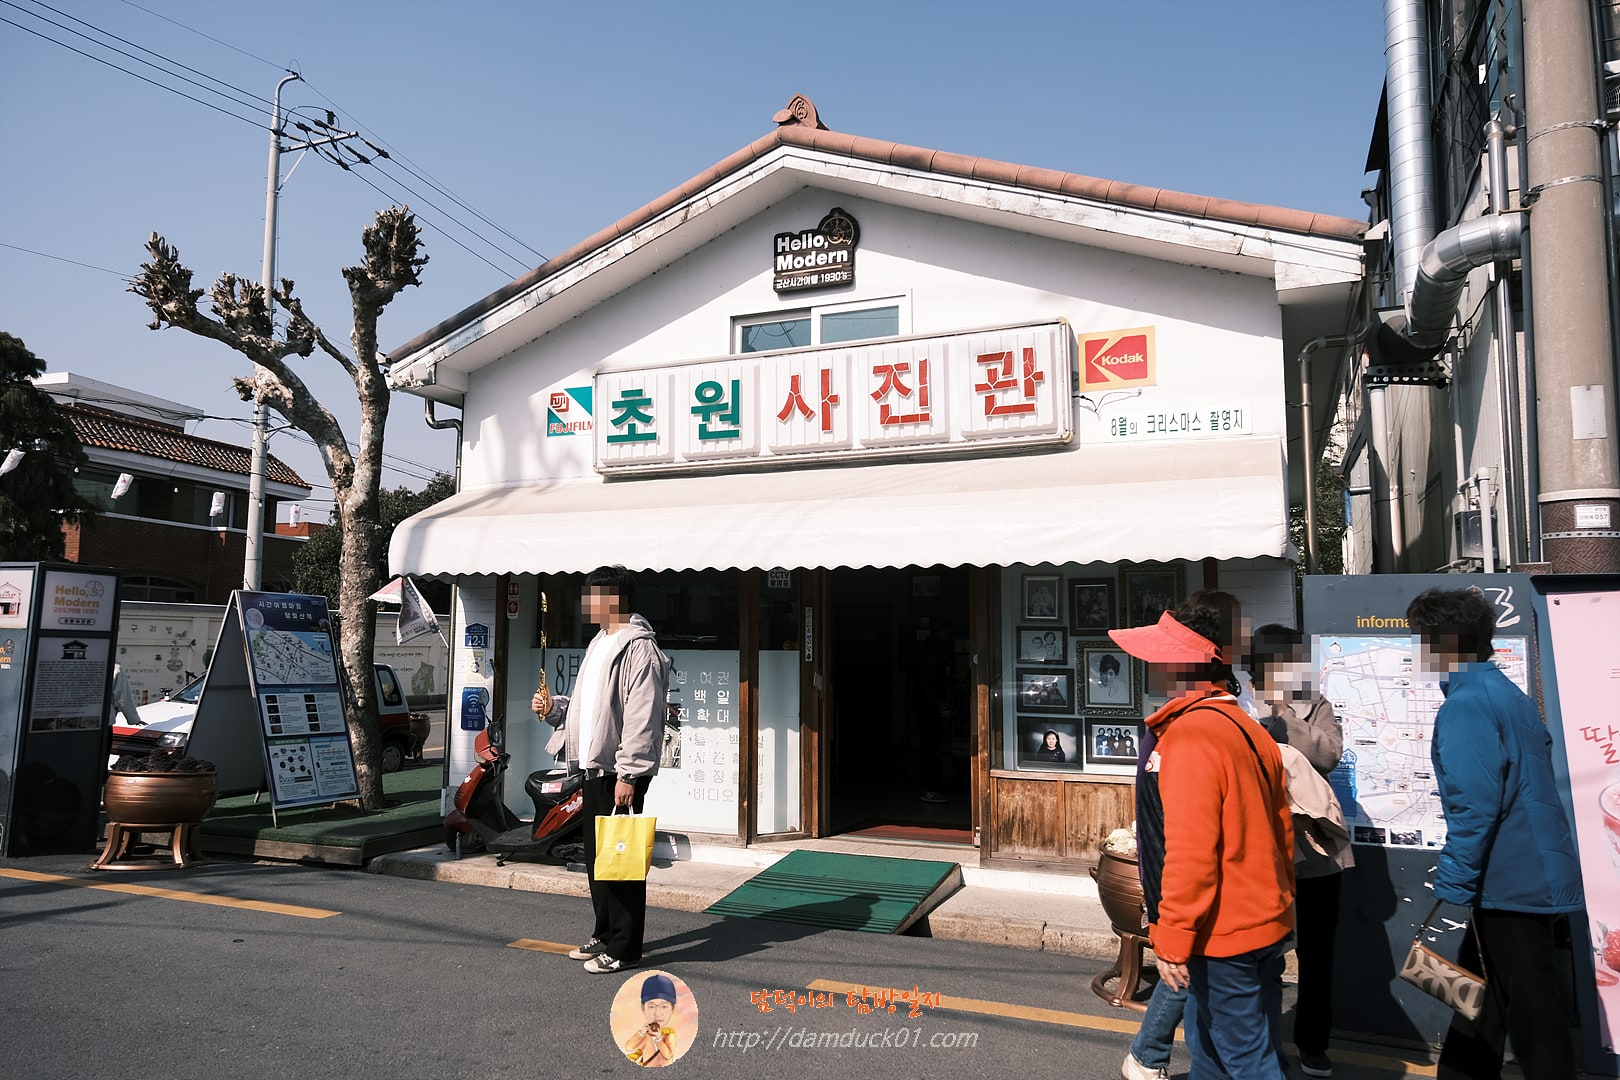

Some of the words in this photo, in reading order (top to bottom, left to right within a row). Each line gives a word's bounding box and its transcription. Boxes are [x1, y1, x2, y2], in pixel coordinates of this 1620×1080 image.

[777, 233, 829, 253] Hello,
[776, 250, 848, 271] Modern
[1101, 353, 1144, 366] Kodak
[1111, 416, 1138, 436] 8월의
[1147, 412, 1202, 434] 크리스마스
[1209, 409, 1243, 431] 촬영지
[770, 571, 789, 579] CCTV
[55, 585, 88, 598] Hello,
[54, 597, 100, 608] Modern
[1357, 615, 1410, 628] informa
[467, 635, 486, 646] 12-1
[1579, 724, 1620, 764] 딸
